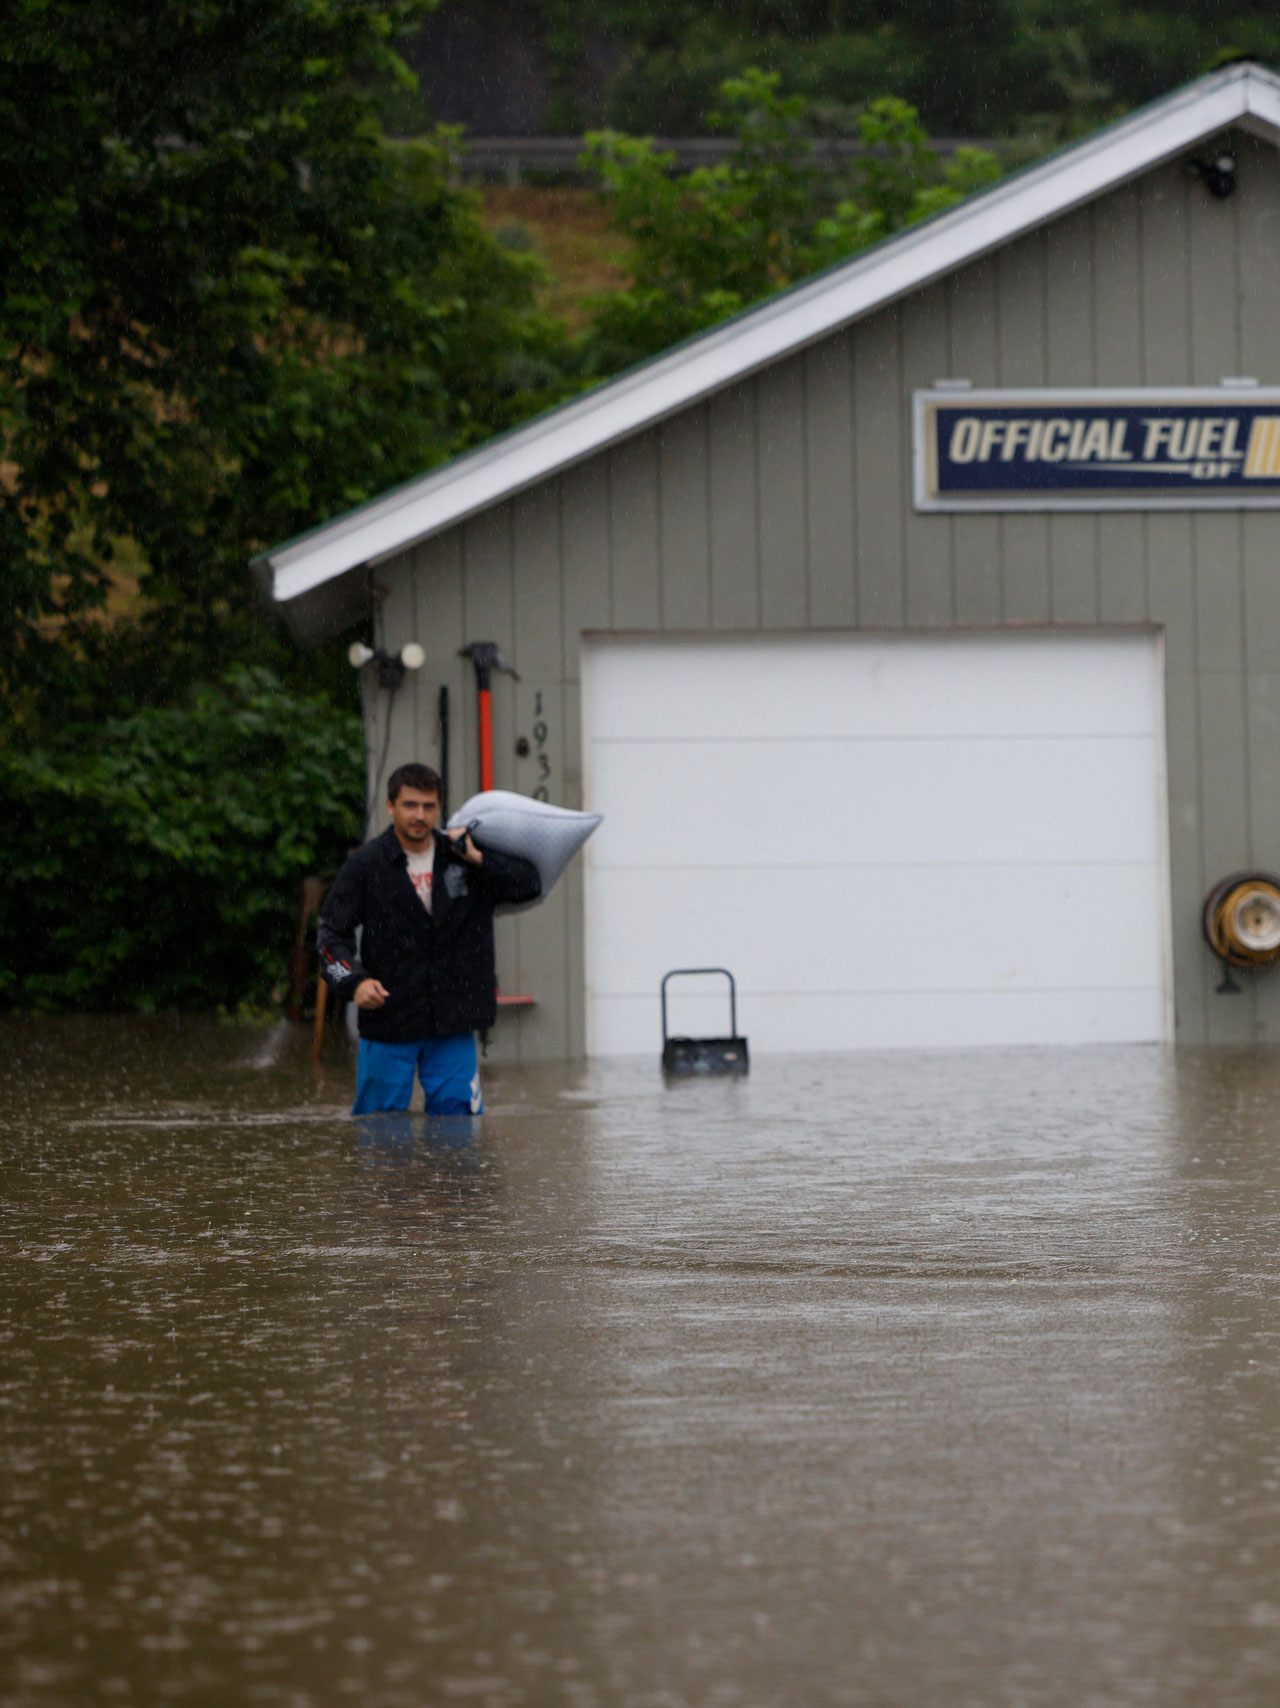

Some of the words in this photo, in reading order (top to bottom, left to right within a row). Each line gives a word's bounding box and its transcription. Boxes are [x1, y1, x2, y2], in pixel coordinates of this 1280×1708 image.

[949, 417, 1132, 463] OFFICIAL
[1139, 417, 1243, 461] FUEL
[1191, 463, 1242, 479] OF
